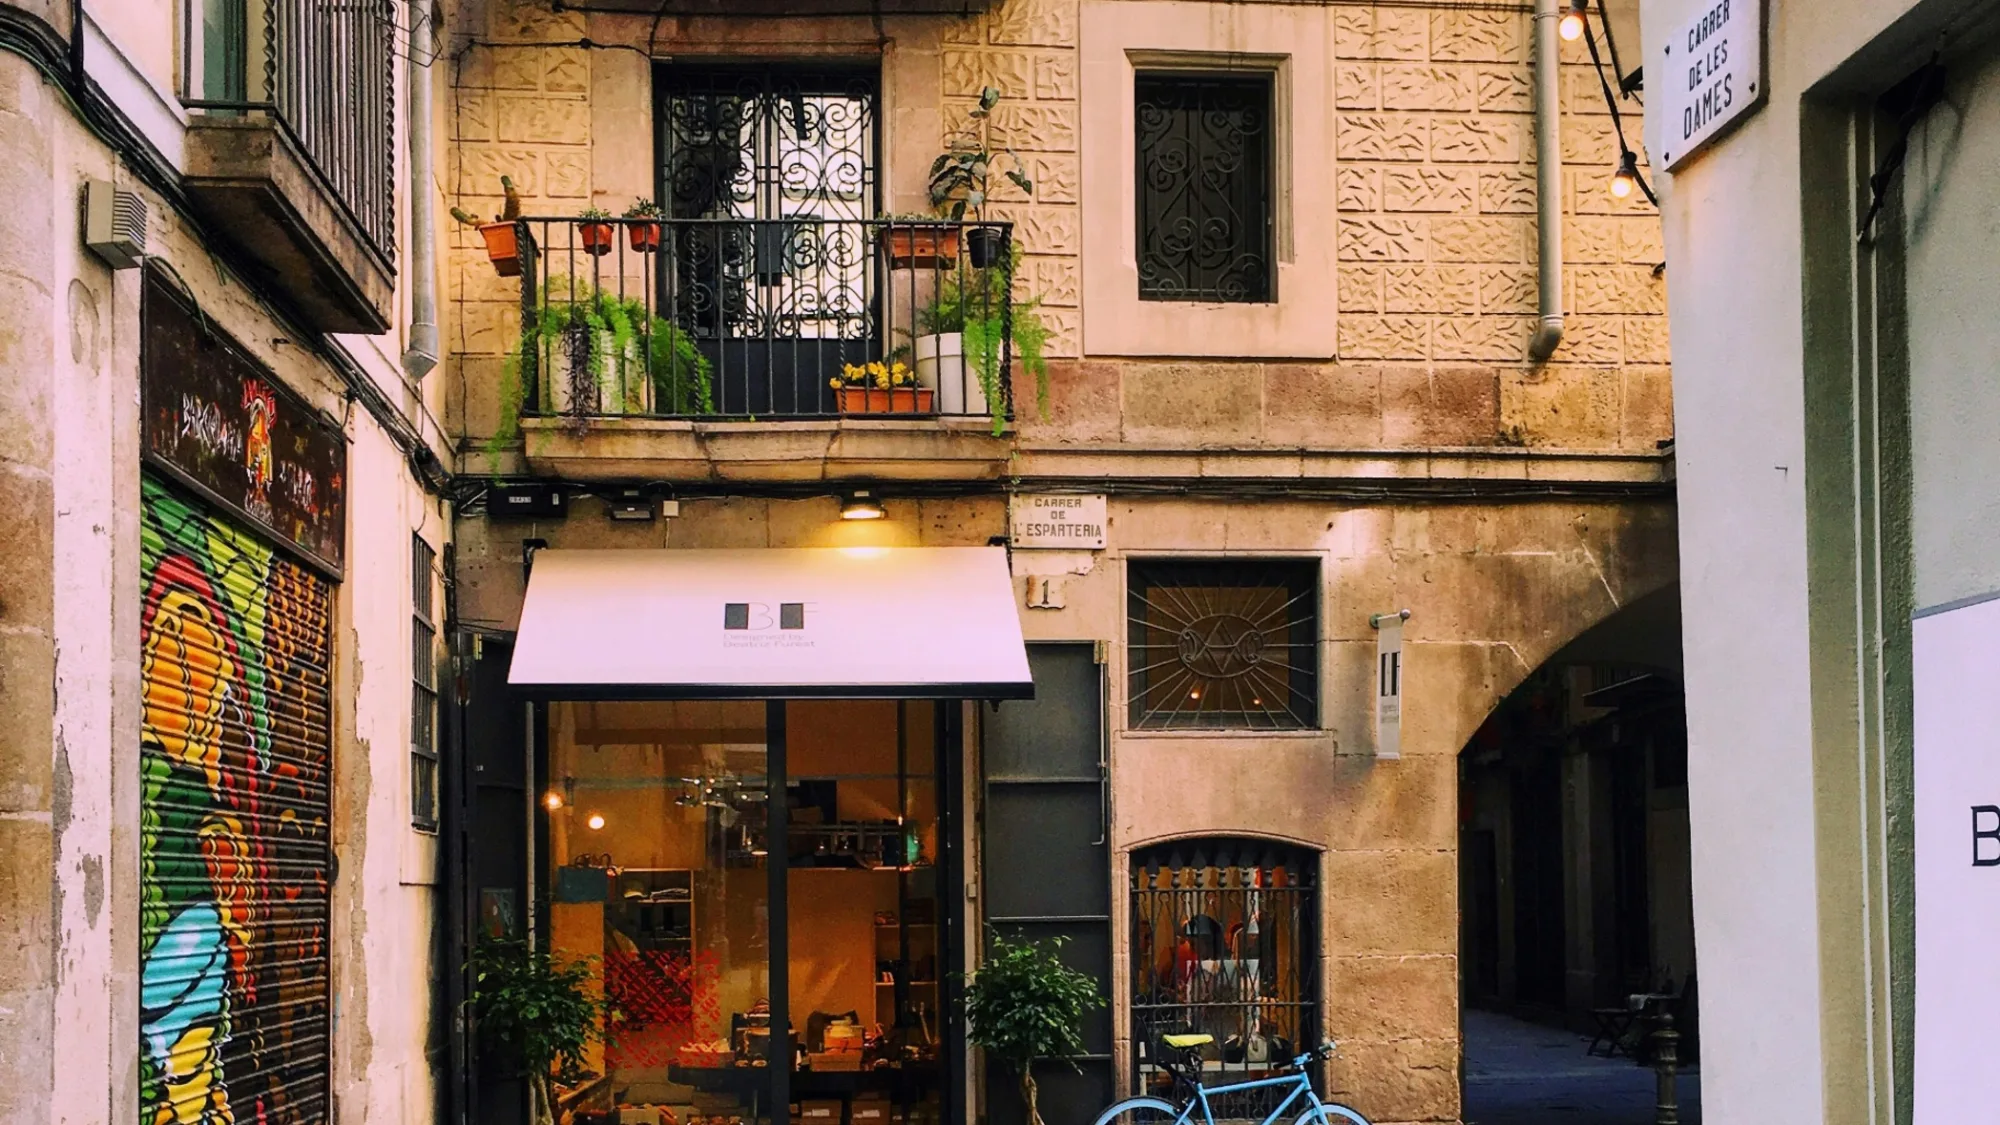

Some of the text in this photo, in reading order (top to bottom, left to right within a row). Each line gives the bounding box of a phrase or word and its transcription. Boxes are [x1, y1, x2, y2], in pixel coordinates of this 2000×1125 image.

[1688, 0, 1730, 54] CARRER
[1689, 39, 1728, 92] DE LES
[1683, 72, 1732, 141] DAMES
[1034, 498, 1082, 508] CARRER
[1050, 510, 1066, 520] DE
[1041, 579, 1050, 605] 1
